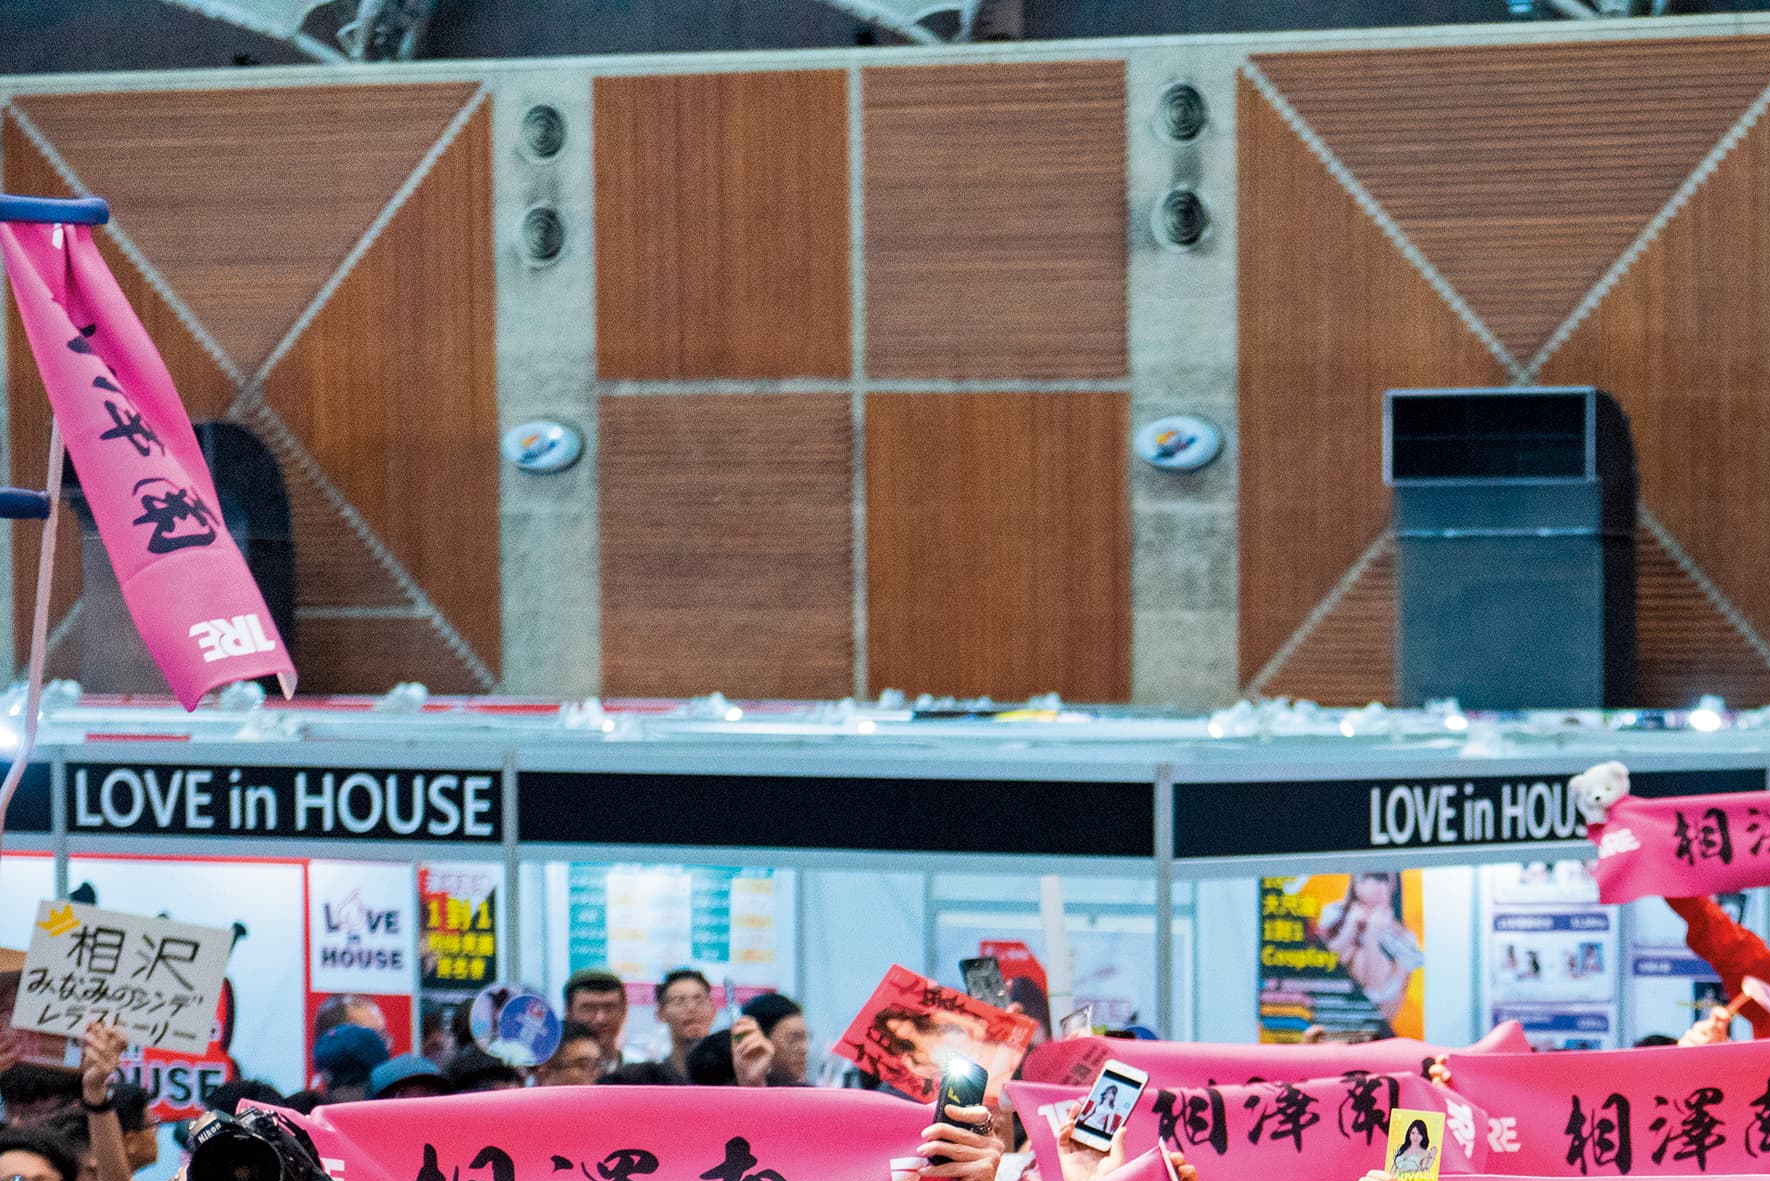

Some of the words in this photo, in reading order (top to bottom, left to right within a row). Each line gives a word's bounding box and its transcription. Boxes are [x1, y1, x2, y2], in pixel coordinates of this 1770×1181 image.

[74, 770, 213, 830] LOVE
[228, 771, 277, 831] in
[294, 773, 494, 837] HOUSE
[1369, 785, 1457, 845] LOVE
[1463, 782, 1494, 842] in
[1502, 778, 1587, 841] HOU
[67, 925, 200, 991] 相沢
[320, 947, 403, 970] HOUSE
[198, 1122, 222, 1144] Nikon
[1487, 1116, 1522, 1153] RE
